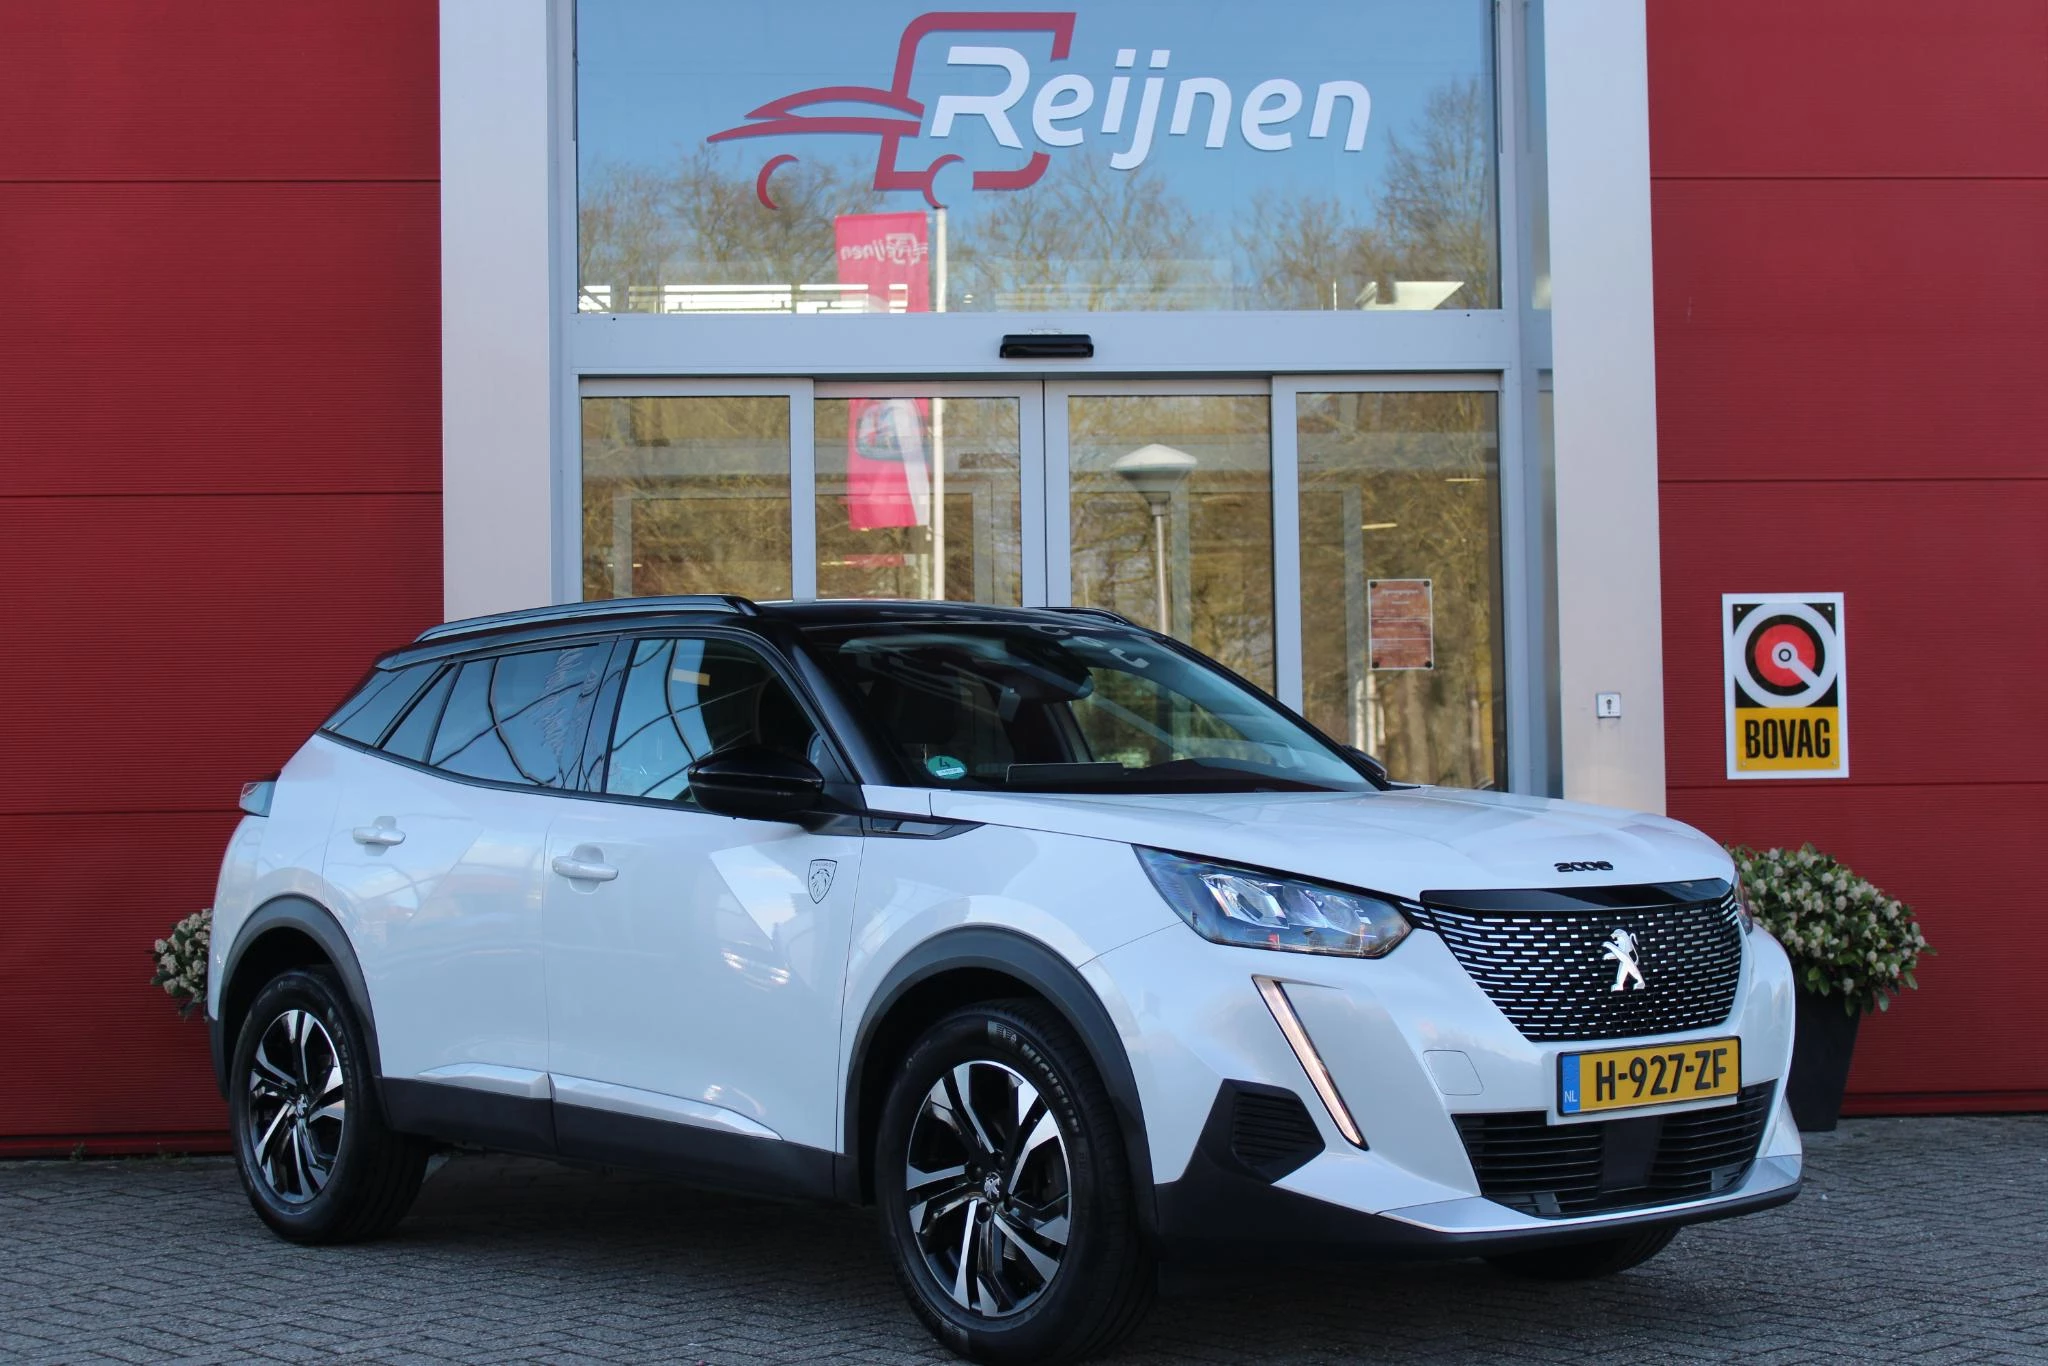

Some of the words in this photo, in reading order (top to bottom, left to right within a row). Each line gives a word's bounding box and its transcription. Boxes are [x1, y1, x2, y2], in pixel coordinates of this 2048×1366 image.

[930, 46, 1371, 170] Reijnen
[1744, 718, 1831, 759] BOVAG
[1554, 861, 1614, 873] 2008
[1595, 1048, 1728, 1102] H-927-ZF
[1564, 1090, 1578, 1103] NL
